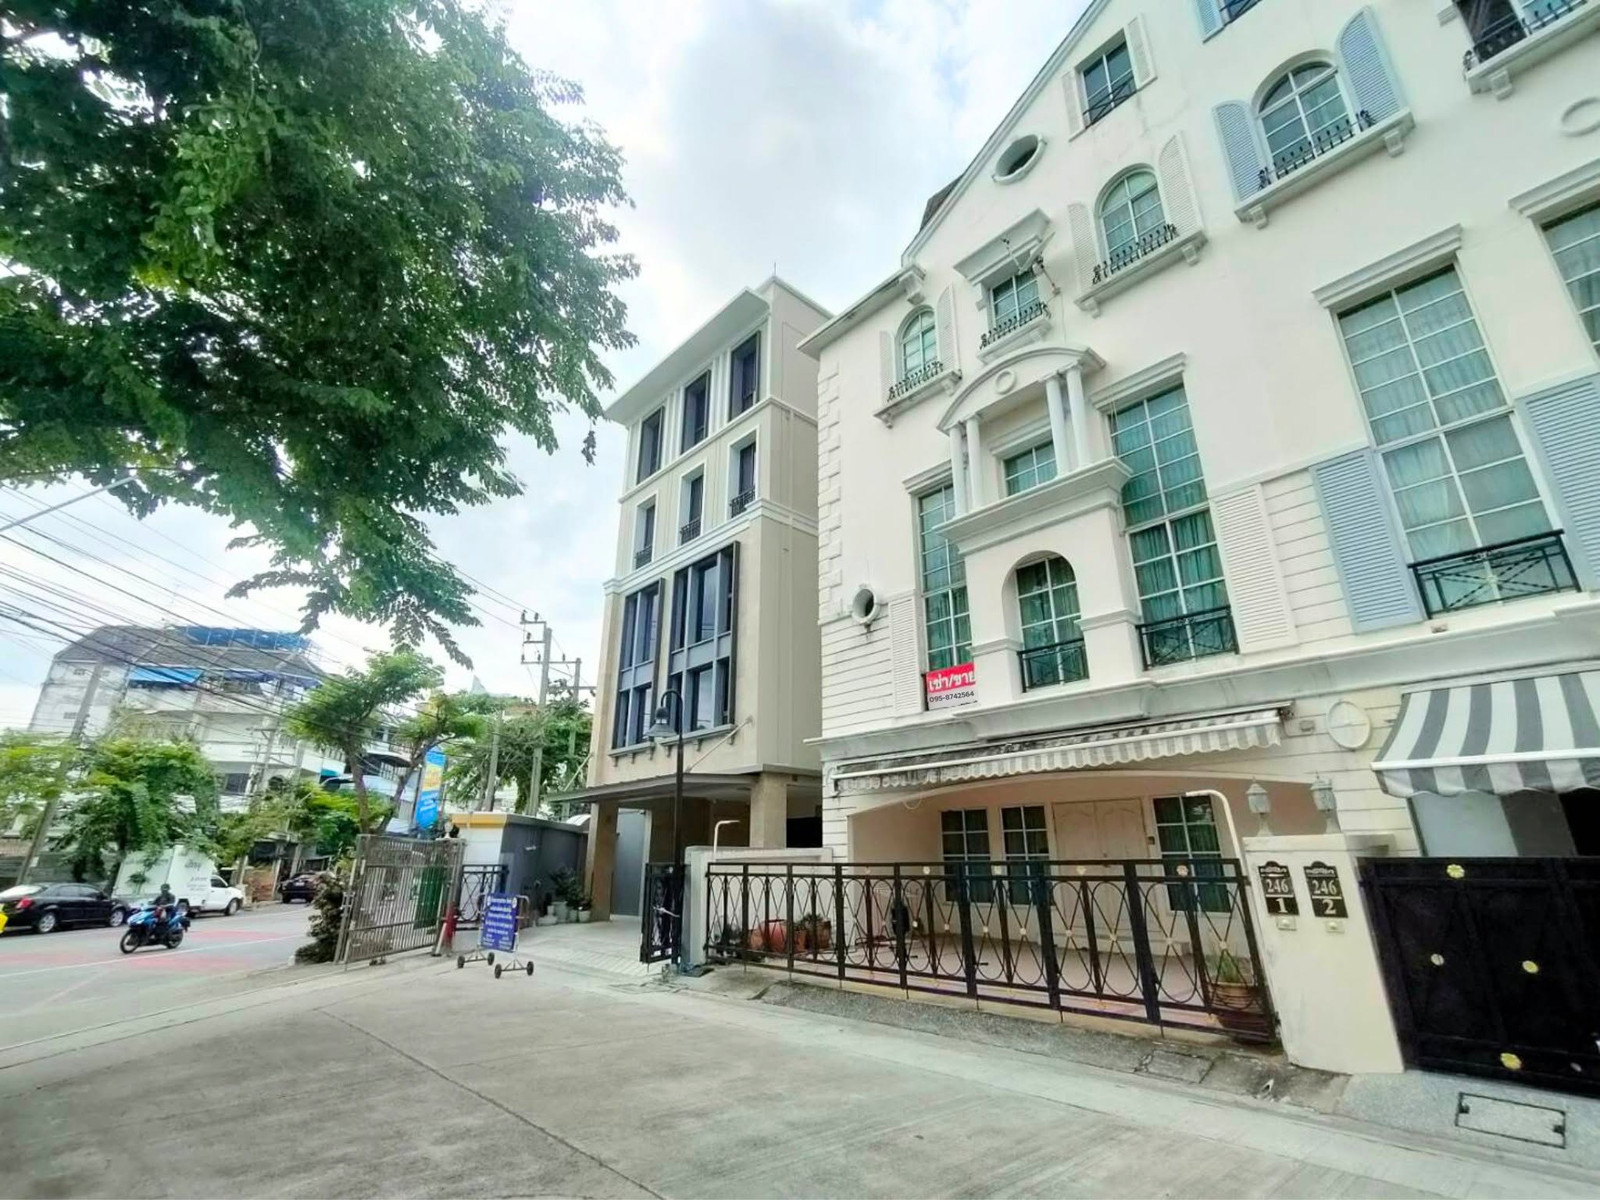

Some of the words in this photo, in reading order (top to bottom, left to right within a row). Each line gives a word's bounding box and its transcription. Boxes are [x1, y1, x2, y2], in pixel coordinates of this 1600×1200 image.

[1266, 879, 1289, 893] 246
[1312, 880, 1337, 895] 246
[1275, 898, 1288, 913] 1
[1322, 900, 1337, 915] 2
